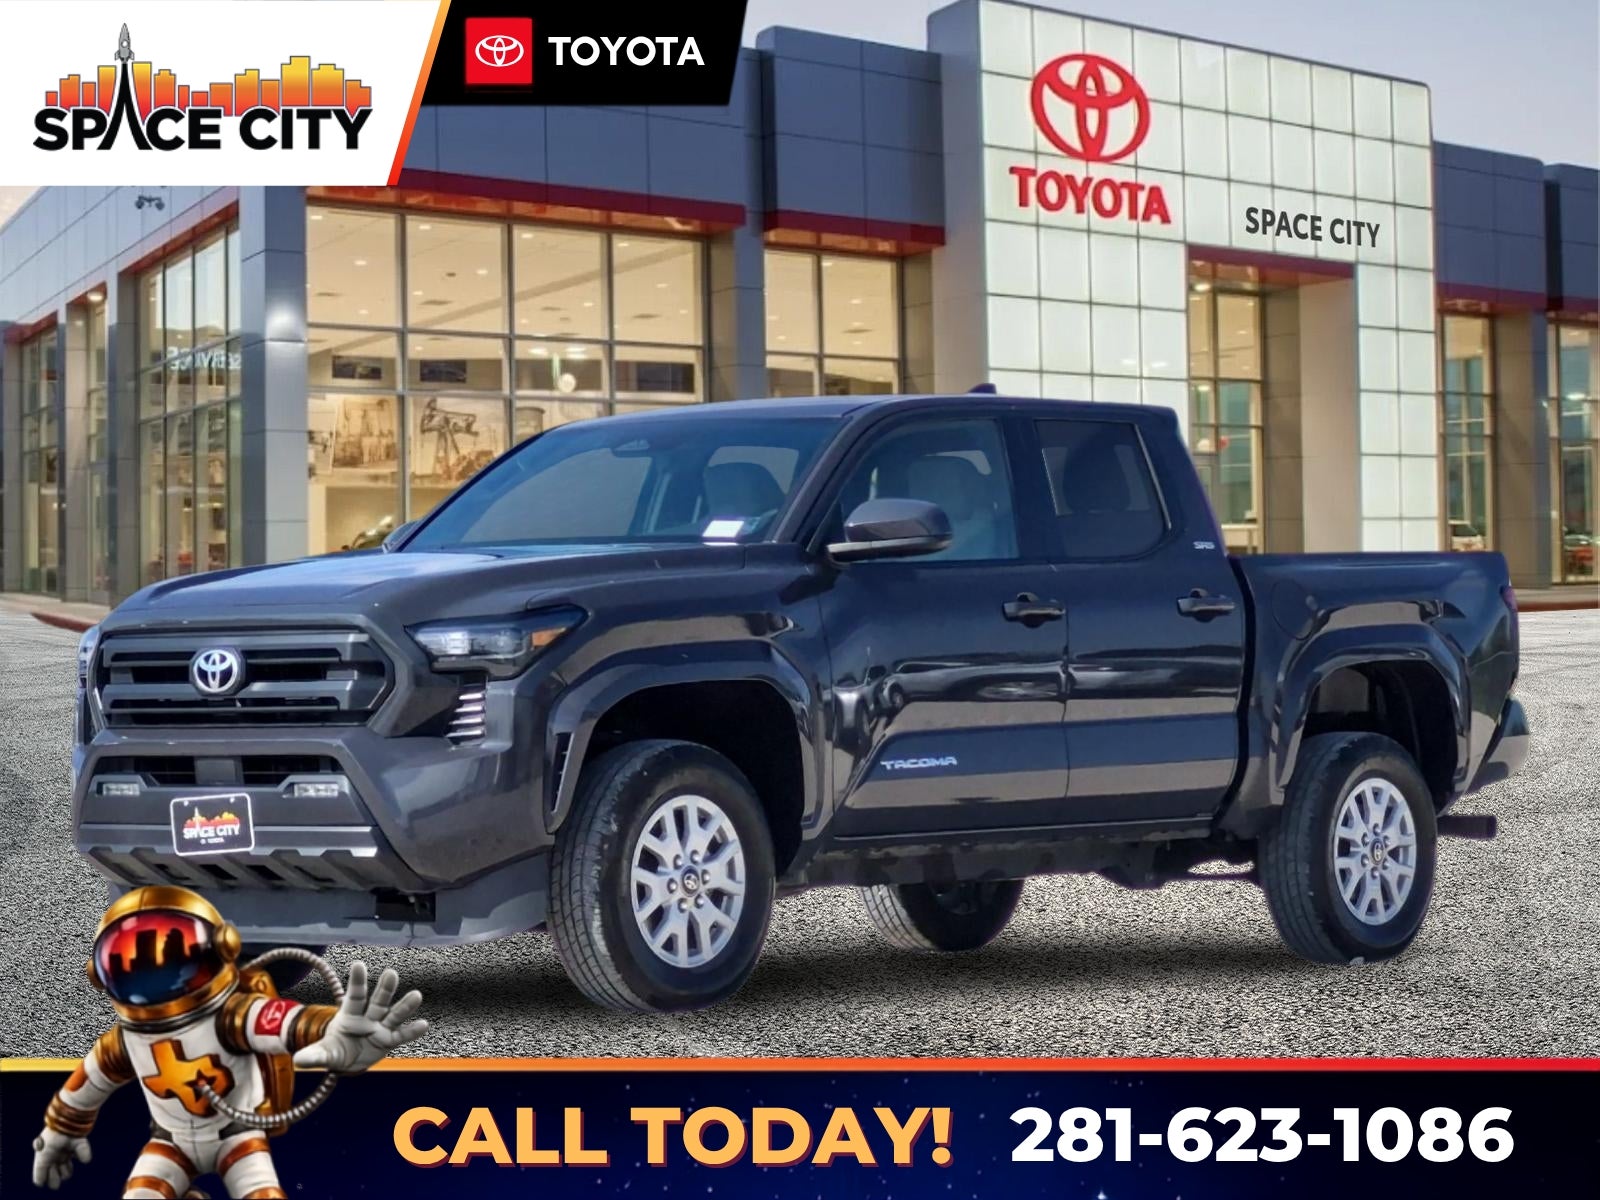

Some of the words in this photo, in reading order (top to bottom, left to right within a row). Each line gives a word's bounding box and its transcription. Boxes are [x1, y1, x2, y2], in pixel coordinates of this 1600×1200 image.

[1009, 166, 1171, 224] TOYOTA
[1245, 206, 1322, 241] SPACE
[1329, 218, 1380, 248] CITY
[880, 756, 958, 770] TACOMA
[183, 826, 215, 839] SPACE
[216, 823, 240, 836] CITY
